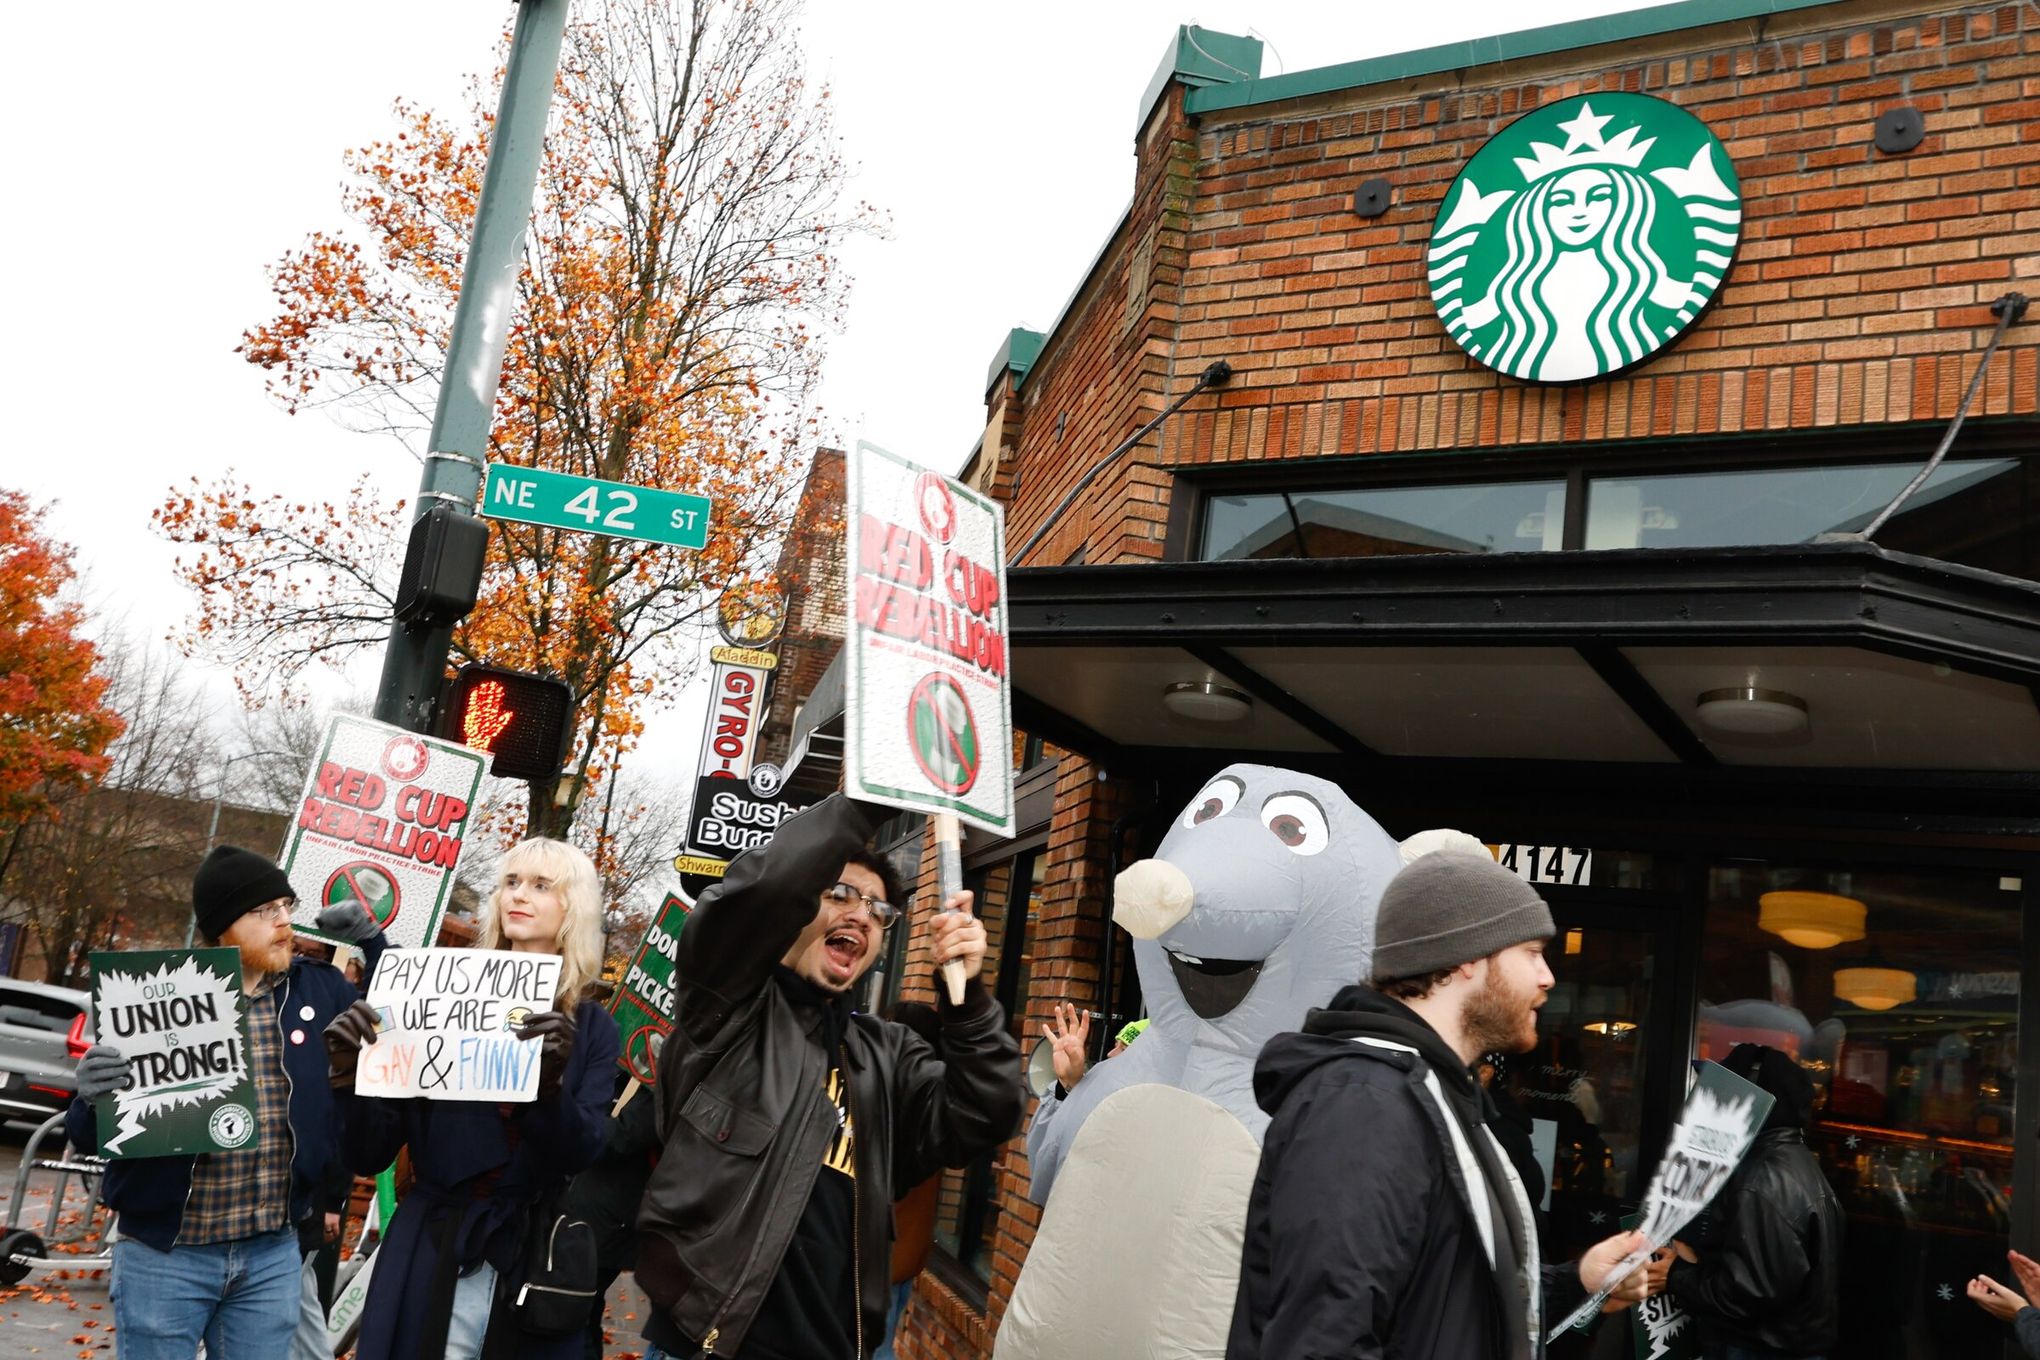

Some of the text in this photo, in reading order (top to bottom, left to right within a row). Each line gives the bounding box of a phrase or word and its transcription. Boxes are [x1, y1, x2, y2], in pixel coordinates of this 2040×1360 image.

[495, 478, 698, 531] NE 42 ST
[857, 513, 1000, 622] RED CUP
[716, 648, 773, 667] Aladdin
[315, 761, 468, 832] RED CUP
[711, 792, 810, 827] Sush
[299, 796, 462, 870] REBELLION
[305, 834, 443, 877] UNFAIR LABOR PRACTICE STRIKE
[1500, 843, 1589, 885] 4147
[143, 982, 177, 1000] OUR
[374, 953, 556, 1002] PAY US MORE
[625, 964, 677, 1020] PICKE
[111, 992, 218, 1038] UNION
[402, 997, 500, 1032] WE ARE
[165, 1032, 180, 1048] IS
[362, 1035, 542, 1092] GAY & FUNNY
